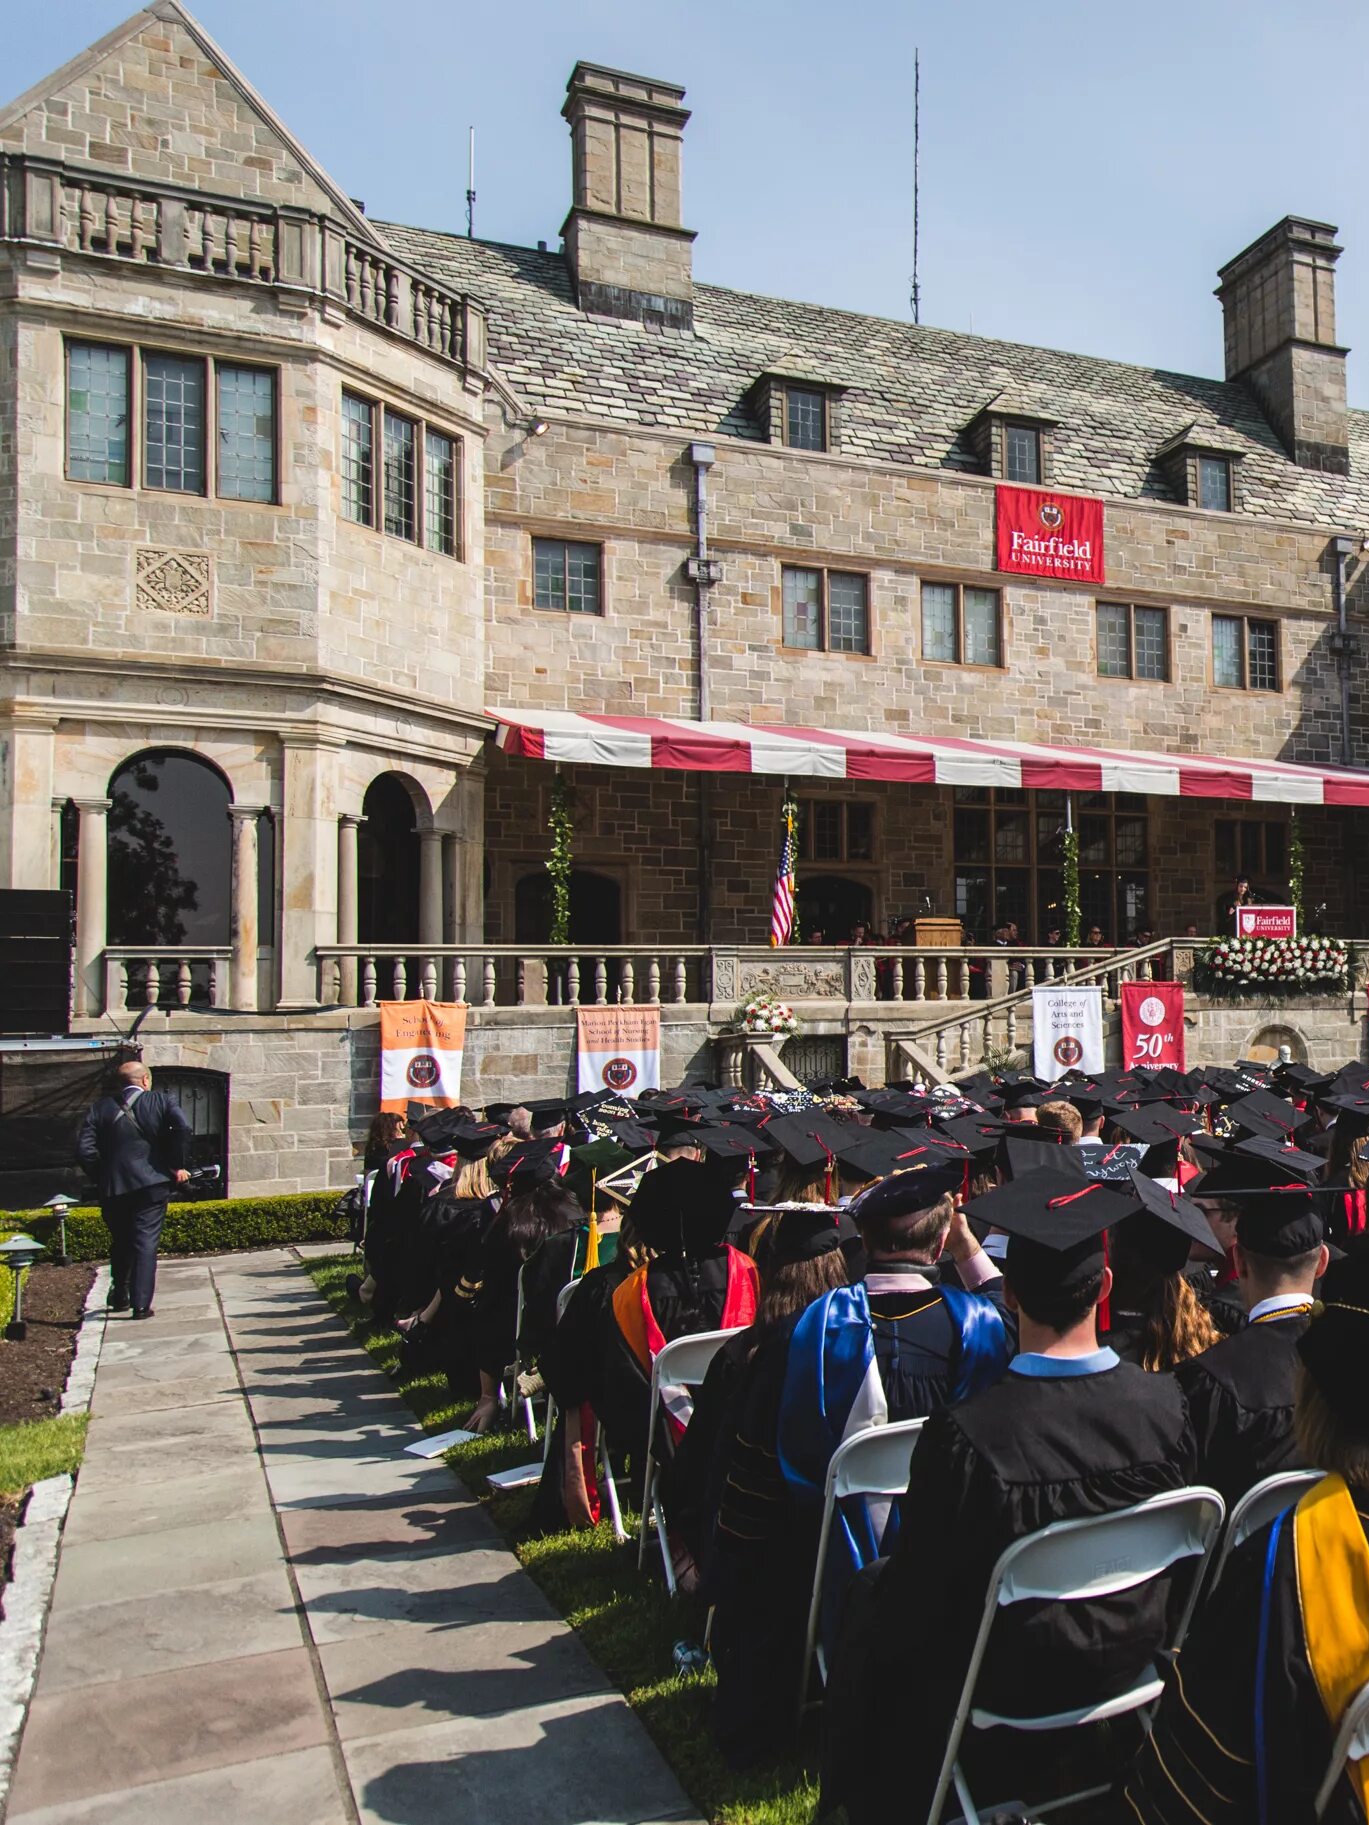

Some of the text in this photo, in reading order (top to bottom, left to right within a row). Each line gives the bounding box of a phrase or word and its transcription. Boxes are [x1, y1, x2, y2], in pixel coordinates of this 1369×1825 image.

[1011, 531, 1092, 559] Fairfield
[1011, 552, 1092, 571] UNIVERSITY
[1256, 916, 1291, 926] Fairfield
[1047, 999, 1087, 1009] College of
[1051, 1010, 1084, 1018] Arts and
[434, 1018, 444, 1028] of
[581, 1019, 611, 1027] Marion
[1051, 1021, 1085, 1030] Sciences
[396, 1028, 451, 1040] Engineeing
[621, 1027, 650, 1036] Nursing
[1132, 1032, 1174, 1059] 50 th
[1129, 1060, 1180, 1071] Aniverary
